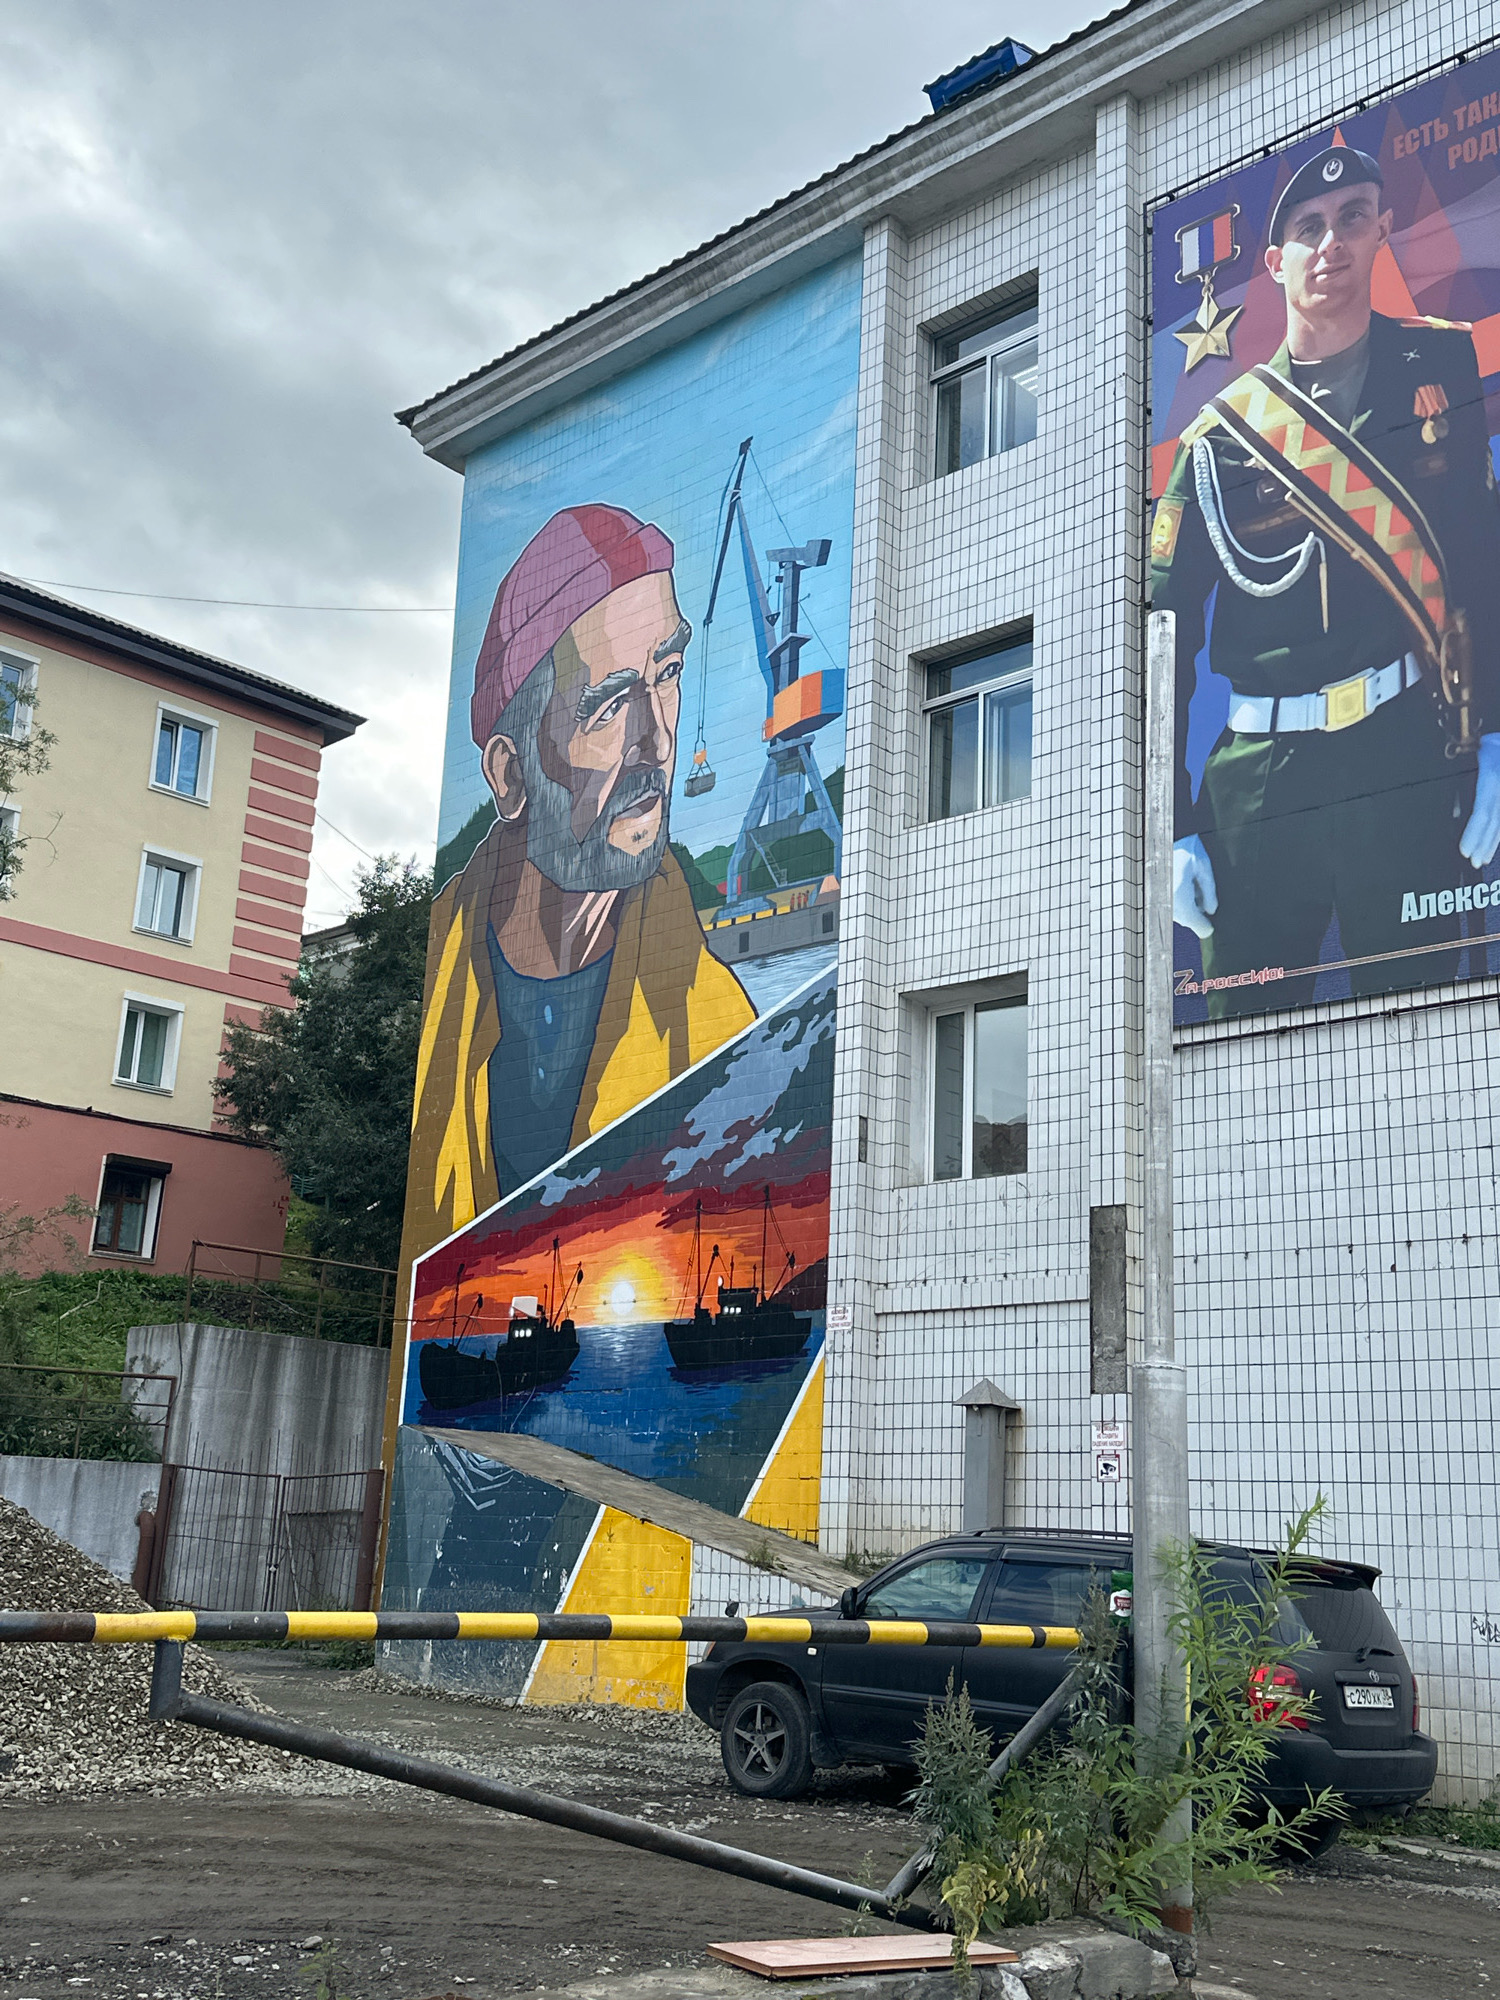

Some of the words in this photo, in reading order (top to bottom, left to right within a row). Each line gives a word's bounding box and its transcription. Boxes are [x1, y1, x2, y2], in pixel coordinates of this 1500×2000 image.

[1393, 117, 1449, 161] ЕСТЬ
[1453, 91, 1500, 132] ТАК
[1447, 124, 1500, 171] РОД
